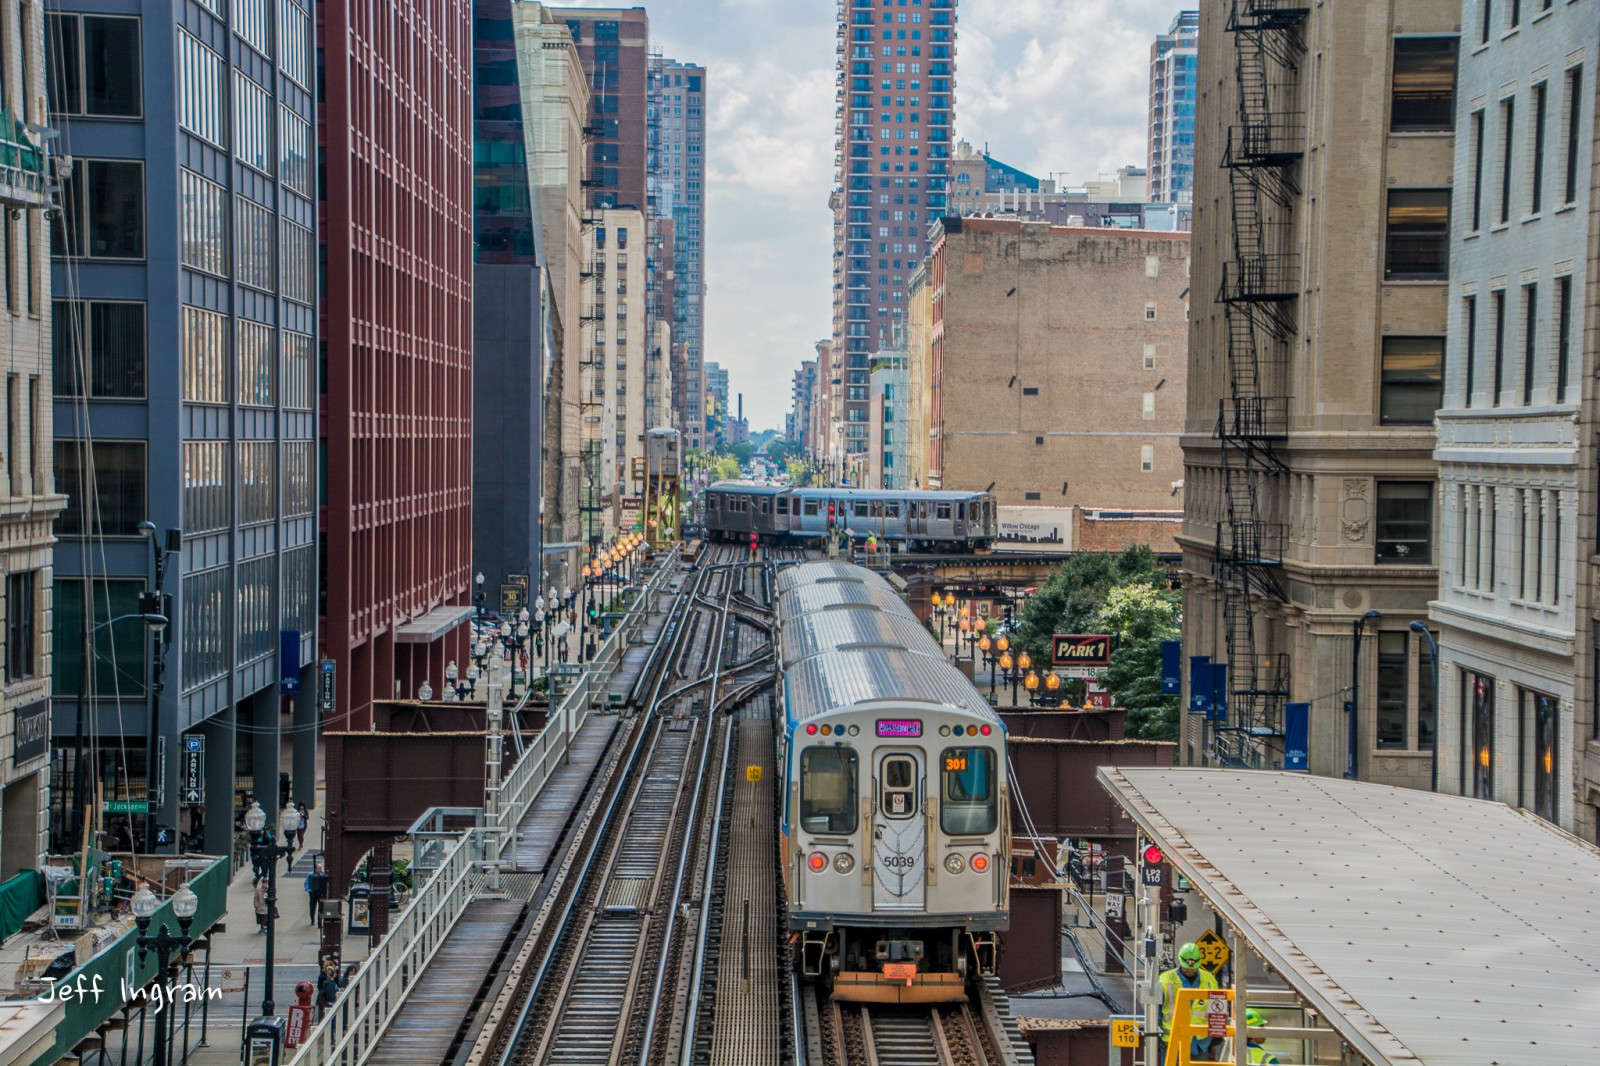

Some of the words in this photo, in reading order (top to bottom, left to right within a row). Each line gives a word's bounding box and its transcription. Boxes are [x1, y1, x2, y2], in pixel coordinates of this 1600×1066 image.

[1057, 642, 1096, 657] PARK
[1098, 642, 1105, 656] 1
[1094, 696, 1102, 705] 24
[946, 758, 966, 770] 301
[884, 857, 914, 867] 5039
[292, 1008, 303, 1028] R
[289, 1027, 301, 1037] ED
